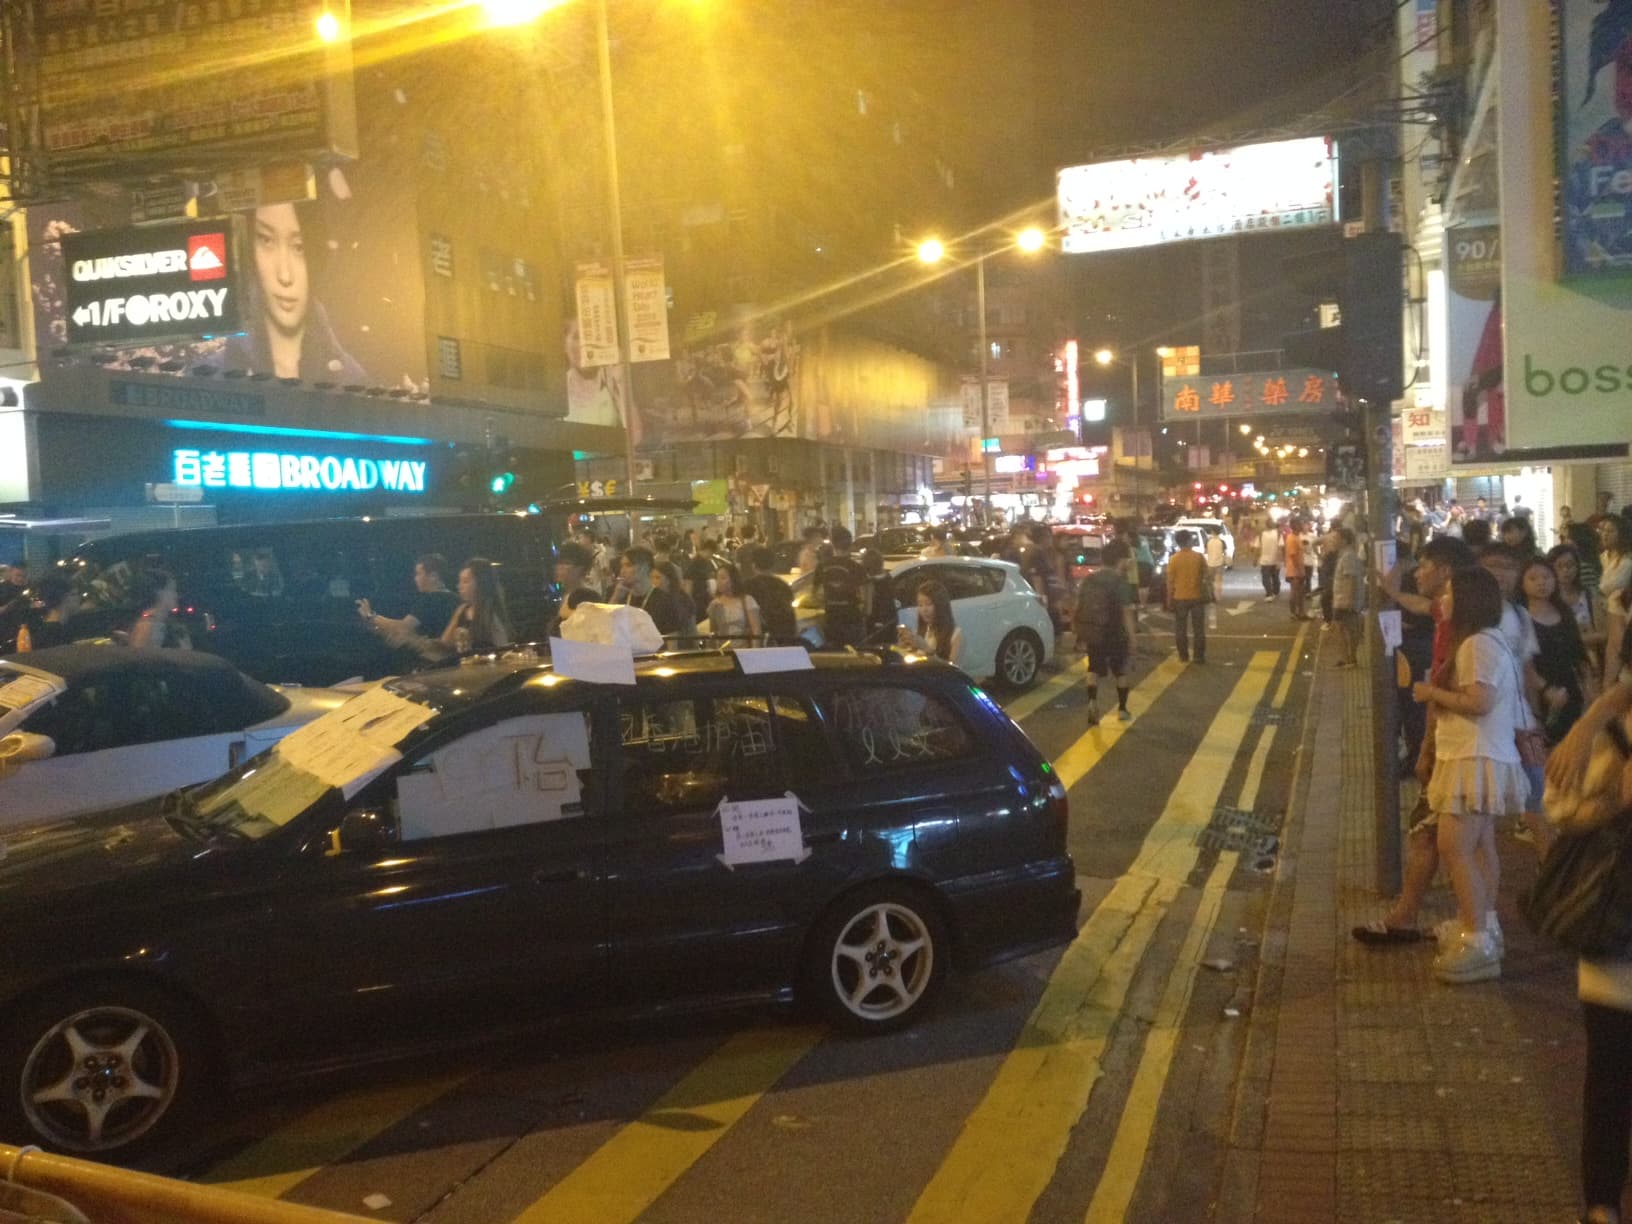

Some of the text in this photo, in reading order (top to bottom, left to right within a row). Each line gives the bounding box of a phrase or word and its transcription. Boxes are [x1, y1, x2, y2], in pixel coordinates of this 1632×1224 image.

[72, 249, 188, 282] QUIKSILVER
[89, 287, 228, 327] 1/F ROXY
[1524, 354, 1632, 397] bos
[281, 455, 426, 491] BROADWAY
